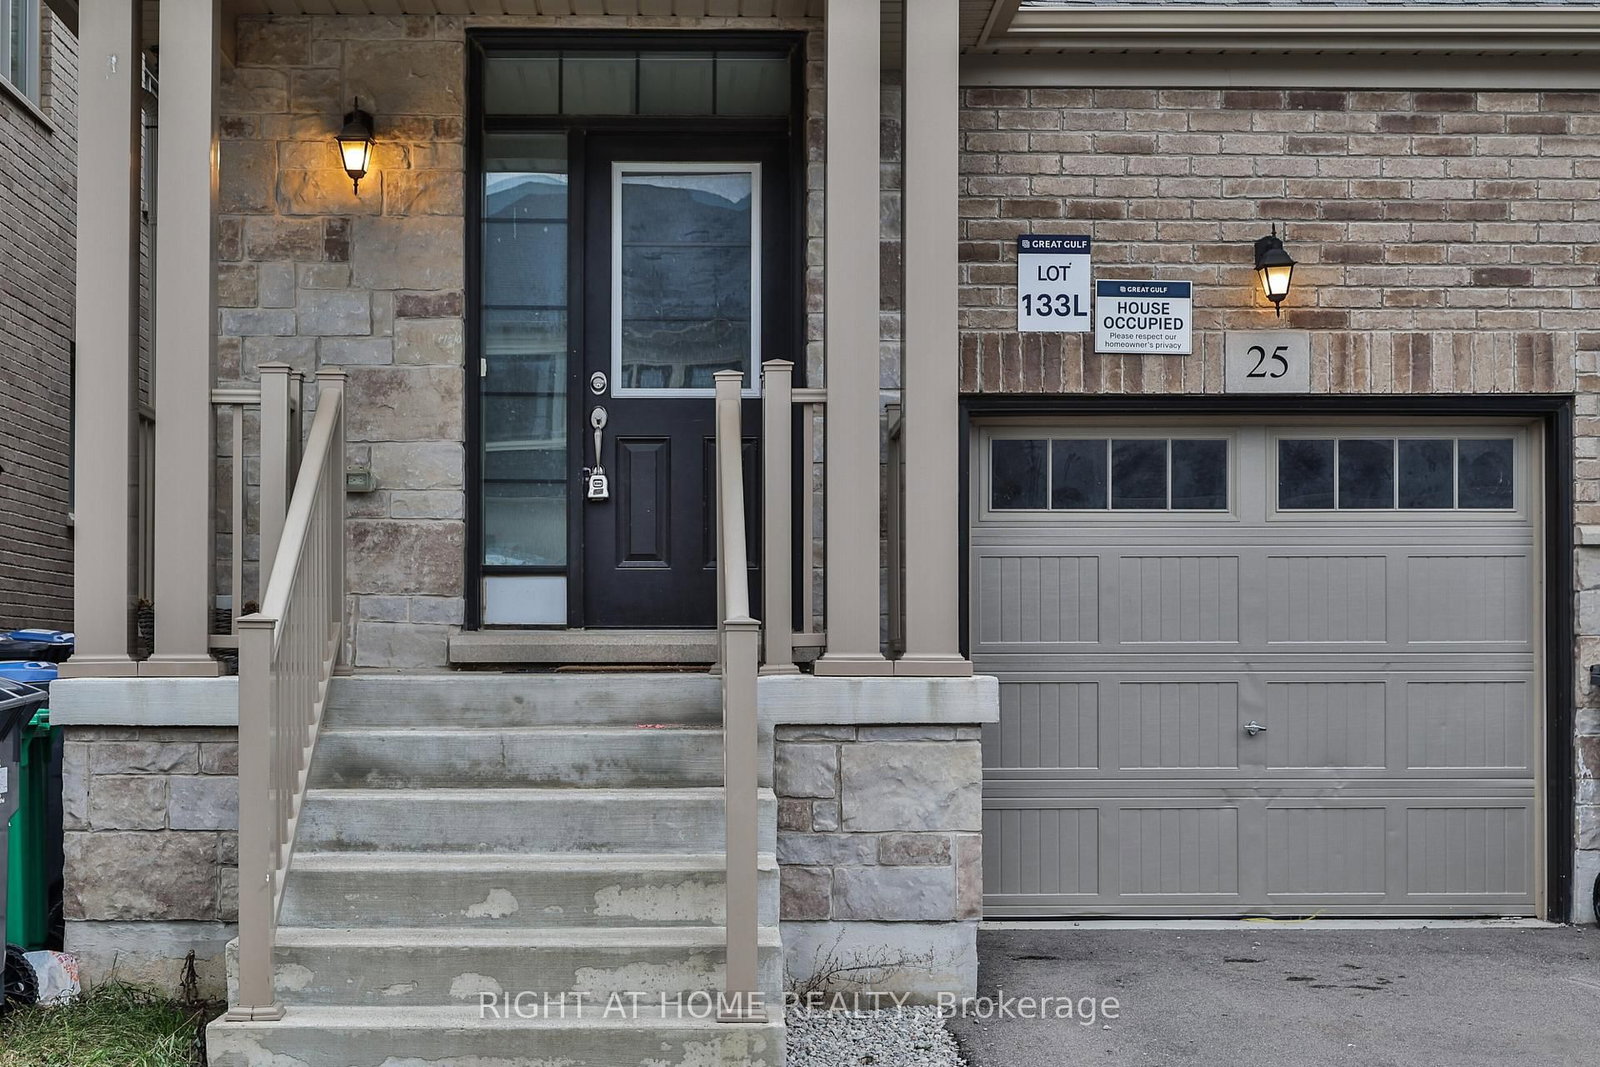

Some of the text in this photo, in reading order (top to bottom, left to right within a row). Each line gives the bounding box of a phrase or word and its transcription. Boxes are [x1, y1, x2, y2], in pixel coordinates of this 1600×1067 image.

[1032, 240, 1088, 249] GREAT GULF
[1037, 265, 1071, 282] LOT
[1021, 293, 1088, 317] 133L
[1117, 301, 1170, 315] HOUSE
[1103, 316, 1184, 330] OCCUPIED
[1109, 332, 1134, 340] Please
[1135, 333, 1163, 342] respect
[1104, 341, 1154, 349] homeowner's
[1246, 345, 1289, 378] 25
